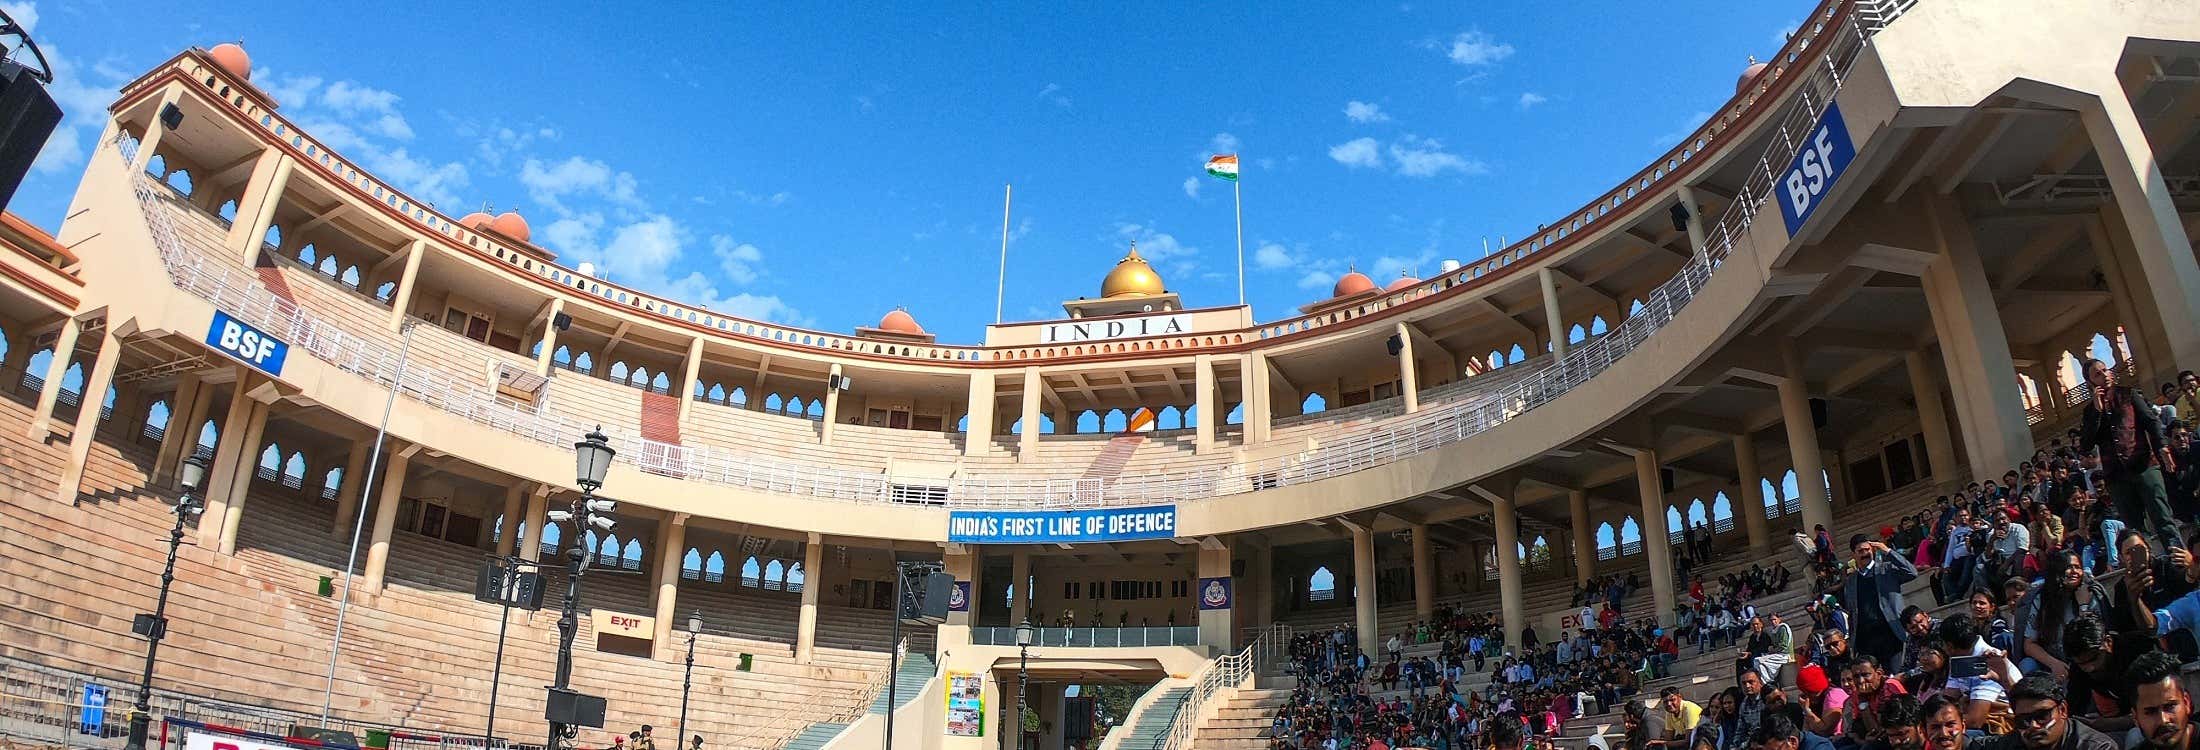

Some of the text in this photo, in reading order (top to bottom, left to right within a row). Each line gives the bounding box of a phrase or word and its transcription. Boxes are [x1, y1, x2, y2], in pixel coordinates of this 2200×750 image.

[1786, 125, 1834, 219] BSF
[220, 319, 277, 364] BSF
[1048, 317, 1183, 342] INDIA
[951, 512, 1173, 536] INDIA'S FIRST LINE OF DEFENCE
[610, 615, 641, 629] EXIT
[1561, 614, 1581, 629] EX
